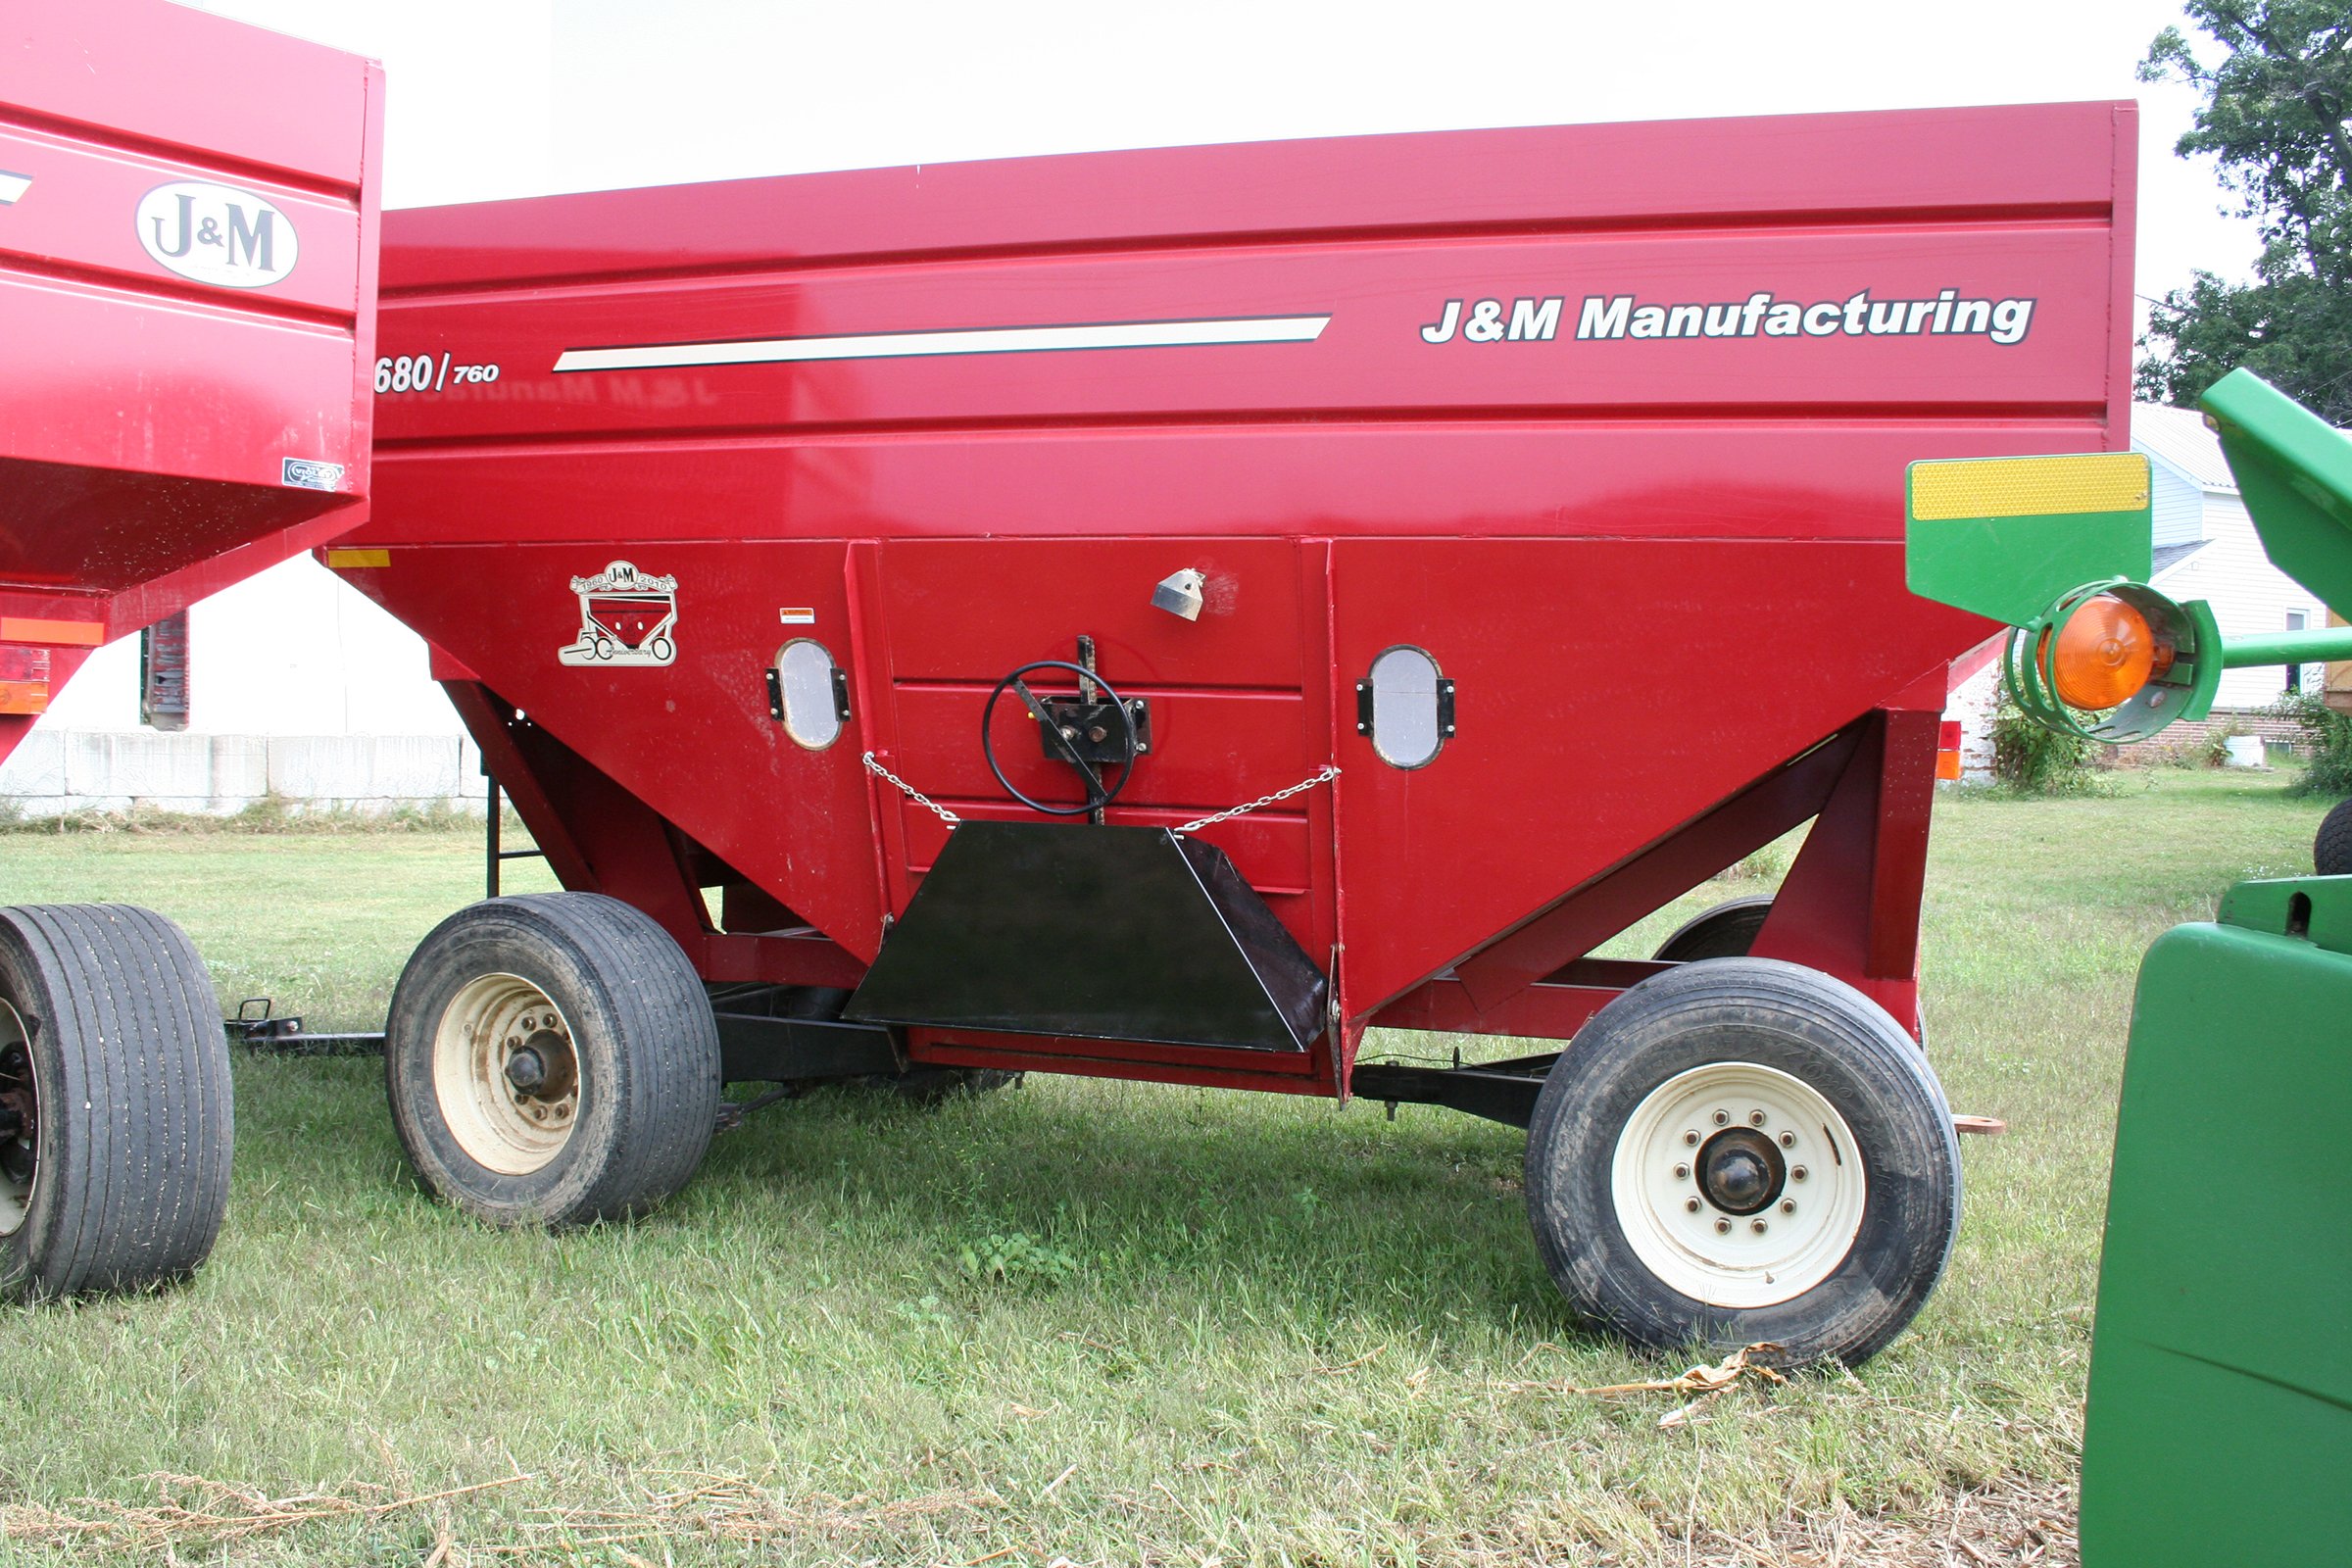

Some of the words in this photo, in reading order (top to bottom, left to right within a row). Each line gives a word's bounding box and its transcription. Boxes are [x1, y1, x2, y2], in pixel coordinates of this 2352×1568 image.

[151, 193, 276, 272] J&M
[1421, 296, 1565, 344] J&M
[1575, 288, 2035, 345] Manufacturing
[609, 567, 634, 583] J&M
[640, 576, 667, 590] 2010
